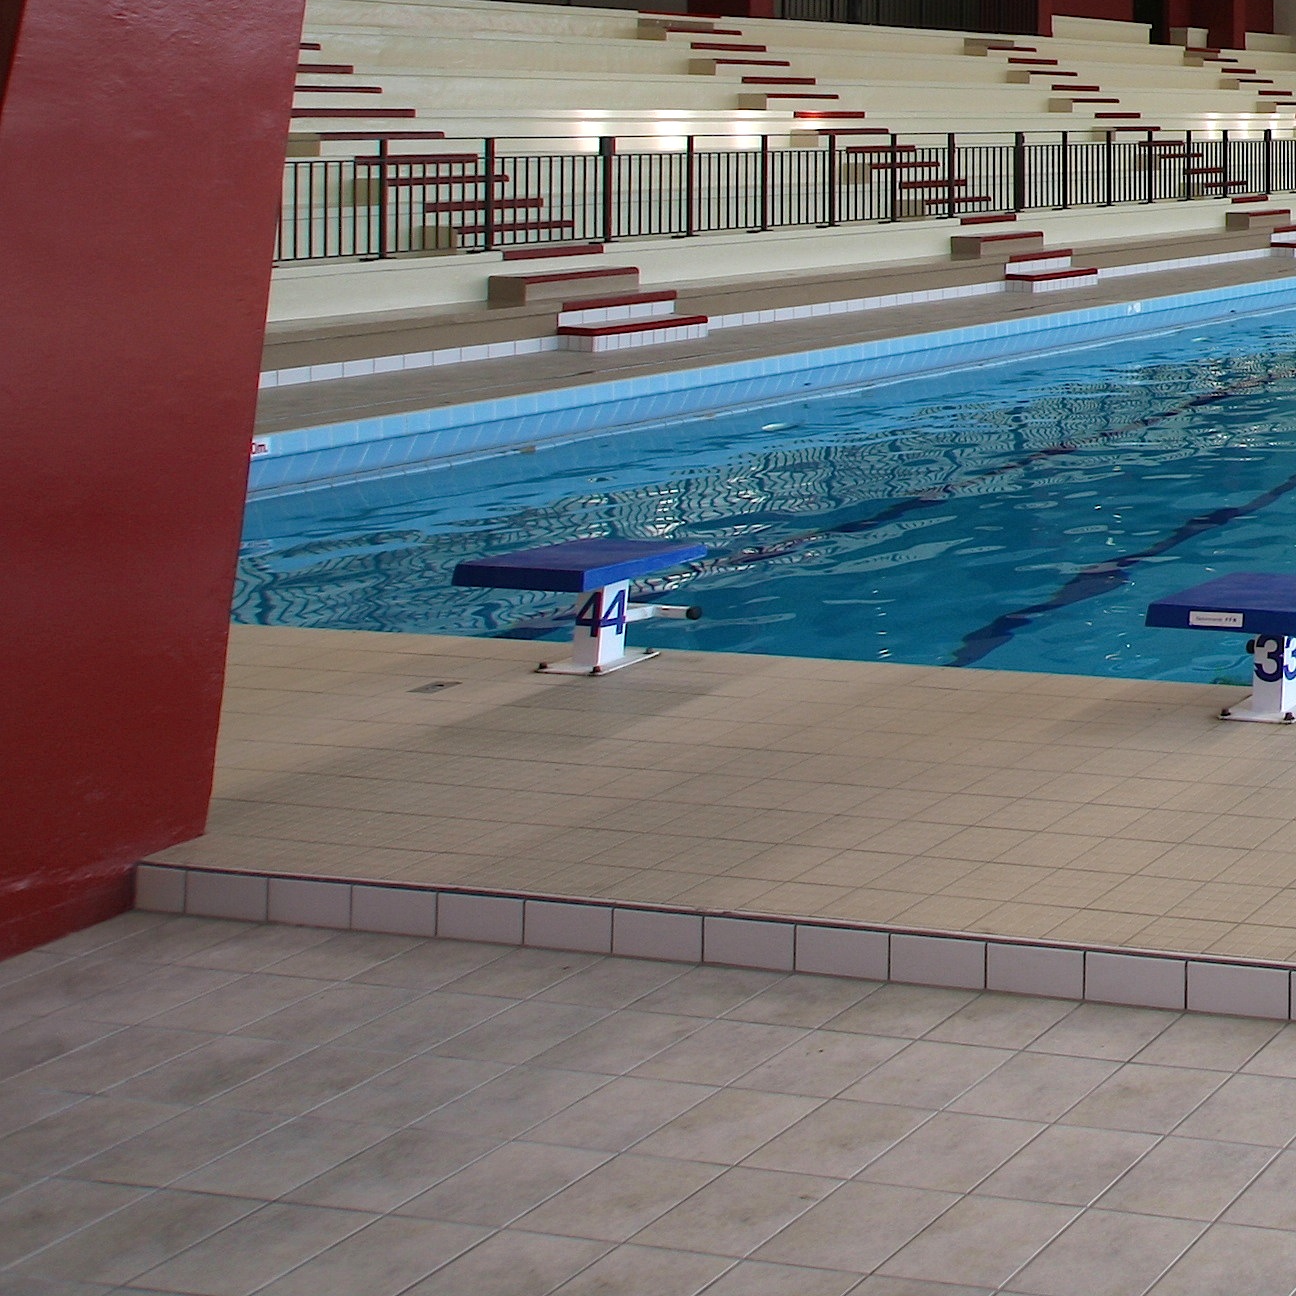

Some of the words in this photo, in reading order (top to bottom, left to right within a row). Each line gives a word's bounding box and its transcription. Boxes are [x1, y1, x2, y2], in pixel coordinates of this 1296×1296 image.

[575, 591, 602, 638] 4
[600, 589, 626, 635] 4
[1254, 633, 1285, 683] 3
